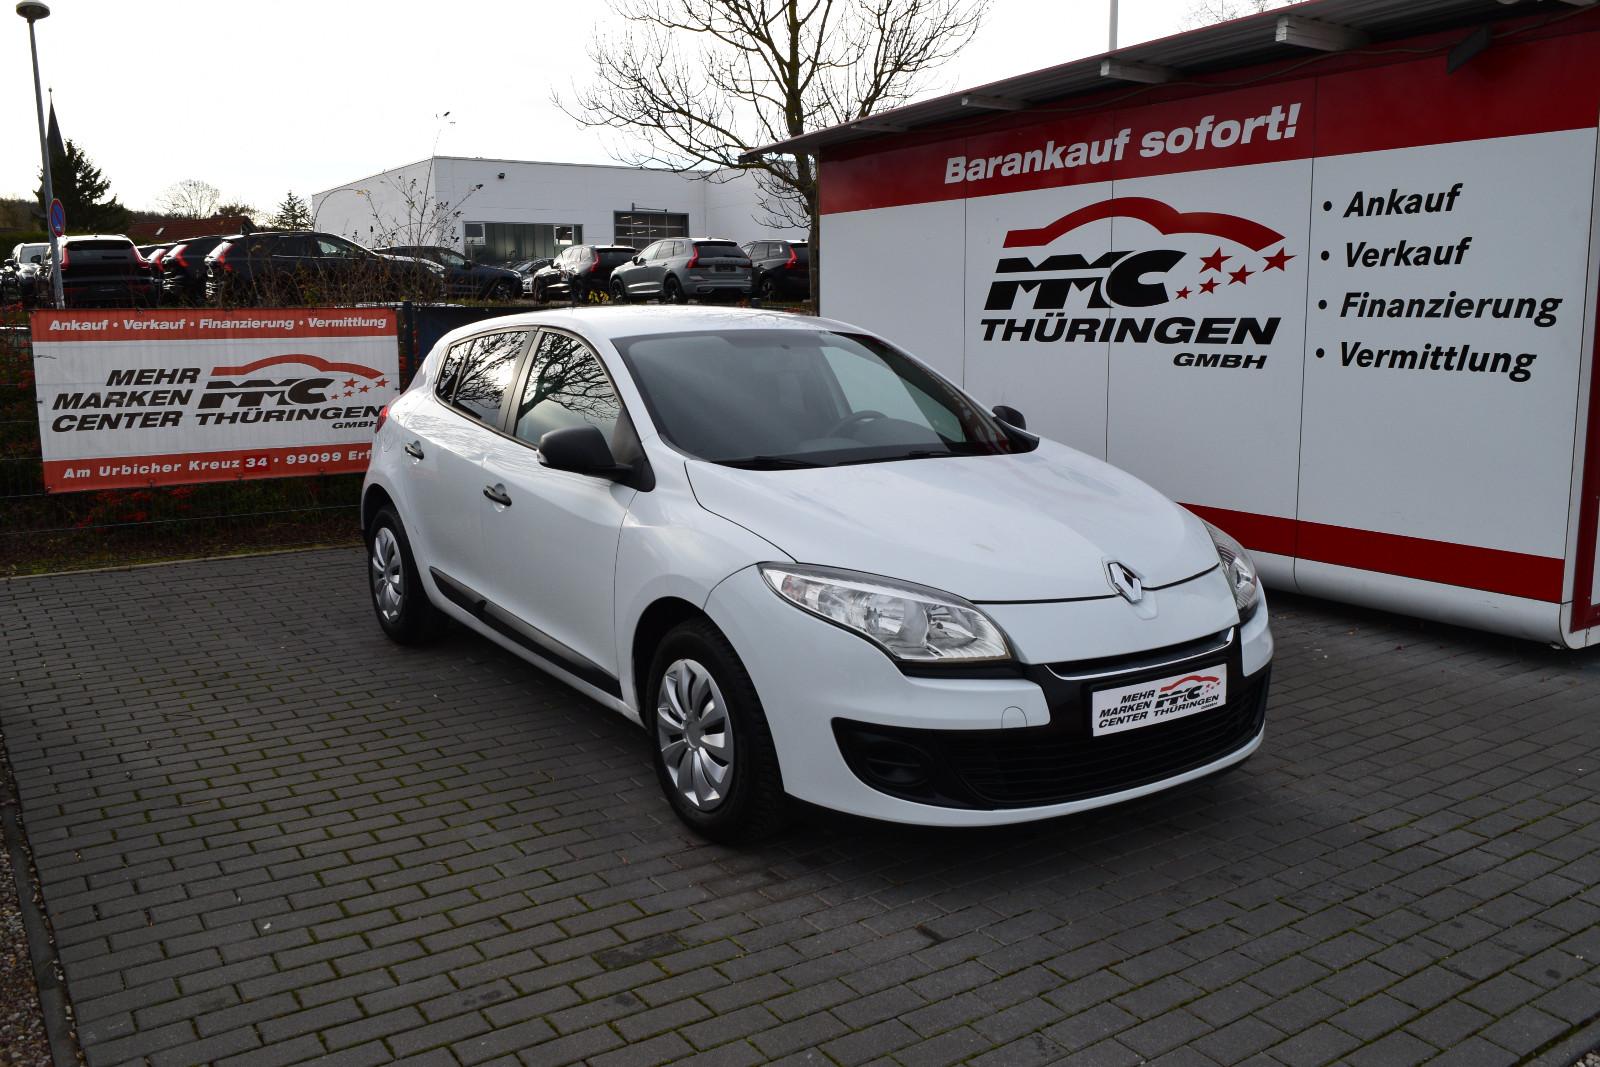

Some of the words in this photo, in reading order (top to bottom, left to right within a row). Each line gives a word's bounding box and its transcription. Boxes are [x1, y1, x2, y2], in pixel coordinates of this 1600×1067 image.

[944, 128, 1132, 184] Barankauf
[1139, 102, 1302, 158] sofort!
[1343, 182, 1463, 218] Ankauf
[1345, 237, 1472, 268] Verkauf
[49, 319, 109, 331] Ankauf
[123, 318, 187, 330] Verkauf
[199, 317, 294, 331] Finanzierung
[307, 316, 387, 329] Vermittlung
[1339, 291, 1562, 328] Finanzierung
[980, 312, 1280, 345] THÜRINGEN
[1172, 352, 1267, 369] GMBH
[1339, 341, 1536, 382] Vermittlung
[106, 367, 201, 387] MEHR
[52, 389, 193, 411] MARKEN
[52, 410, 184, 433] CENTER
[197, 405, 385, 426] THÜRINGEN
[332, 421, 377, 429] GMBH
[63, 468, 91, 479] Am
[99, 462, 182, 477] Urbicher
[188, 459, 240, 472] Kreuz
[245, 457, 268, 469] 34
[286, 452, 342, 465] 99099
[348, 449, 372, 461] Erf
[1099, 700, 1152, 718] MARKEN
[1120, 689, 1156, 704] MEHR
[1098, 710, 1149, 729] CENTER
[1153, 694, 1220, 717] THÜRINGEN
